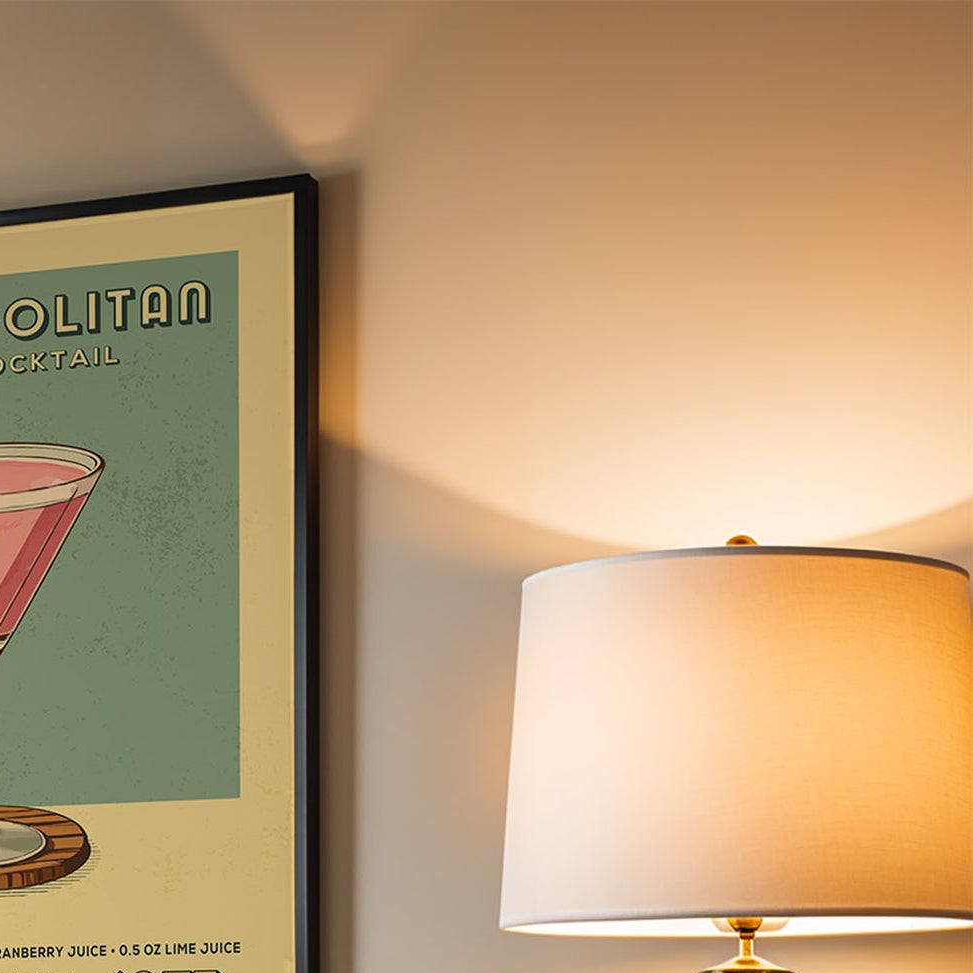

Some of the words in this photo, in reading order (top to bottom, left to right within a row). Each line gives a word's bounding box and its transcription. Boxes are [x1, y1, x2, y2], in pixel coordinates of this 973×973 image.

[67, 944, 107, 957] JUICE
[119, 944, 140, 956] 0.5
[144, 943, 161, 956] OZ
[165, 942, 196, 955] LIME
[200, 941, 241, 954] JUICE
